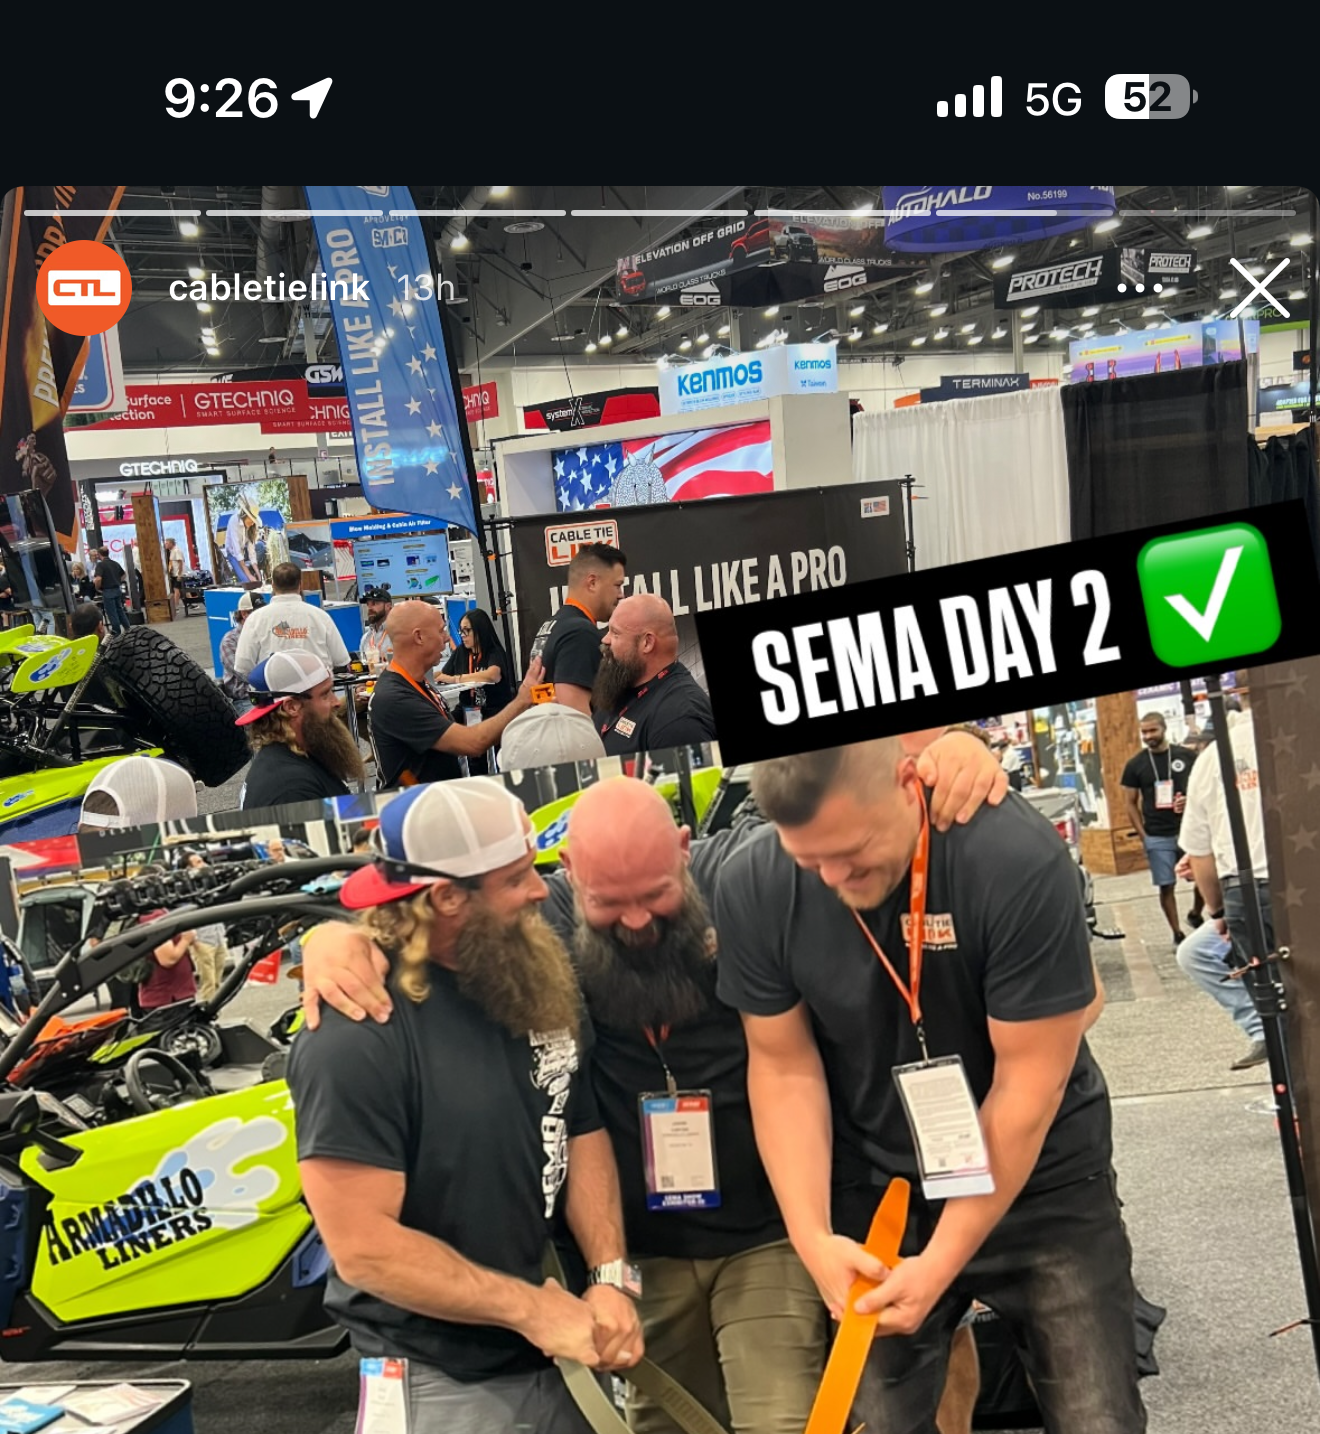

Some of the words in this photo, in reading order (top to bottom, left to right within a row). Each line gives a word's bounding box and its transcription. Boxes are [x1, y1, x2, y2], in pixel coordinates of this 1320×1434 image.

[635, 240, 690, 265] ELEVATION
[692, 231, 714, 248] OFF
[716, 220, 746, 239] GRID
[1150, 254, 1192, 268] PROTECH
[823, 272, 868, 293] EOG
[1008, 259, 1103, 294] PROTECH
[680, 294, 721, 306] EOG
[952, 377, 1020, 390] TERMINAX
[194, 389, 294, 410] GTECHNIQ
[355, 379, 396, 486] INSTALL
[119, 459, 199, 477] GTECHNIQ
[550, 528, 592, 543] CABLE
[593, 526, 613, 538] TIE
[551, 539, 613, 560] LI
[694, 557, 760, 612] LIKE
[766, 554, 788, 600] A
[790, 545, 849, 596] PRO
[45, 1168, 204, 1266] ARMADILLO
[95, 1207, 213, 1271] LINERS
